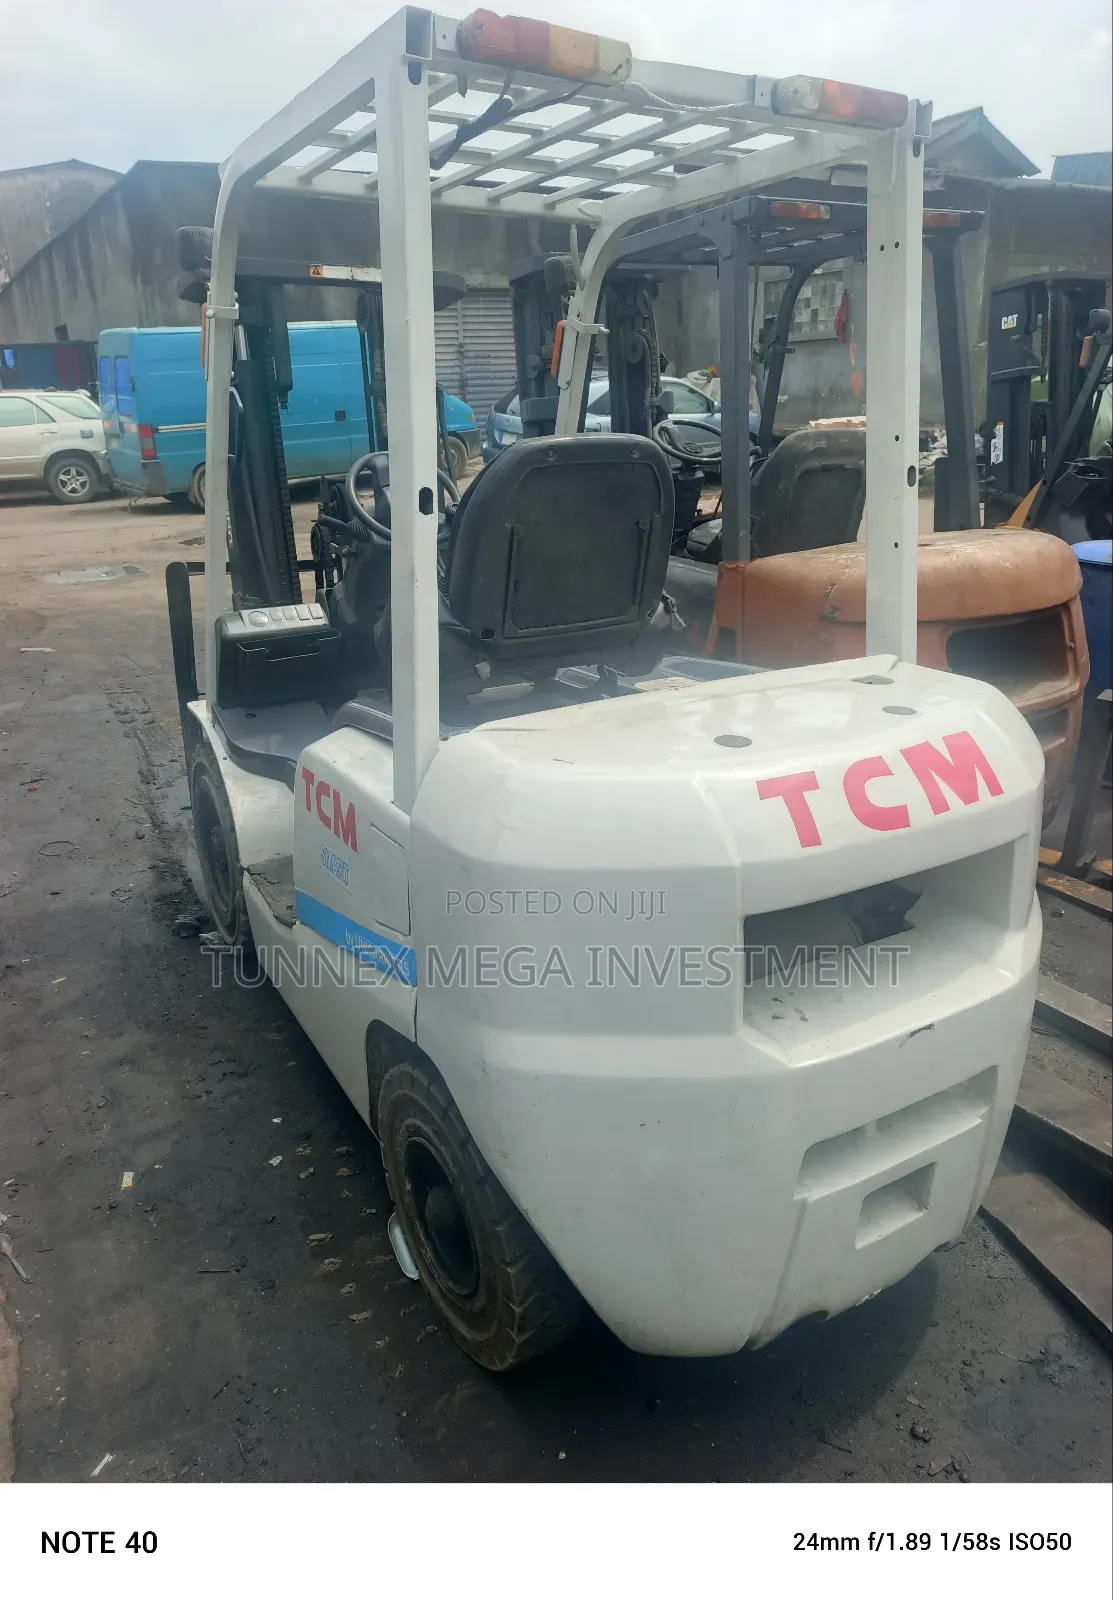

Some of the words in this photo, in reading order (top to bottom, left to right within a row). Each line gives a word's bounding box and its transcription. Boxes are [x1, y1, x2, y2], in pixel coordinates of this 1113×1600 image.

[1001, 313, 1019, 330] CAT
[301, 765, 359, 854] TCM
[756, 730, 1004, 848] TCM
